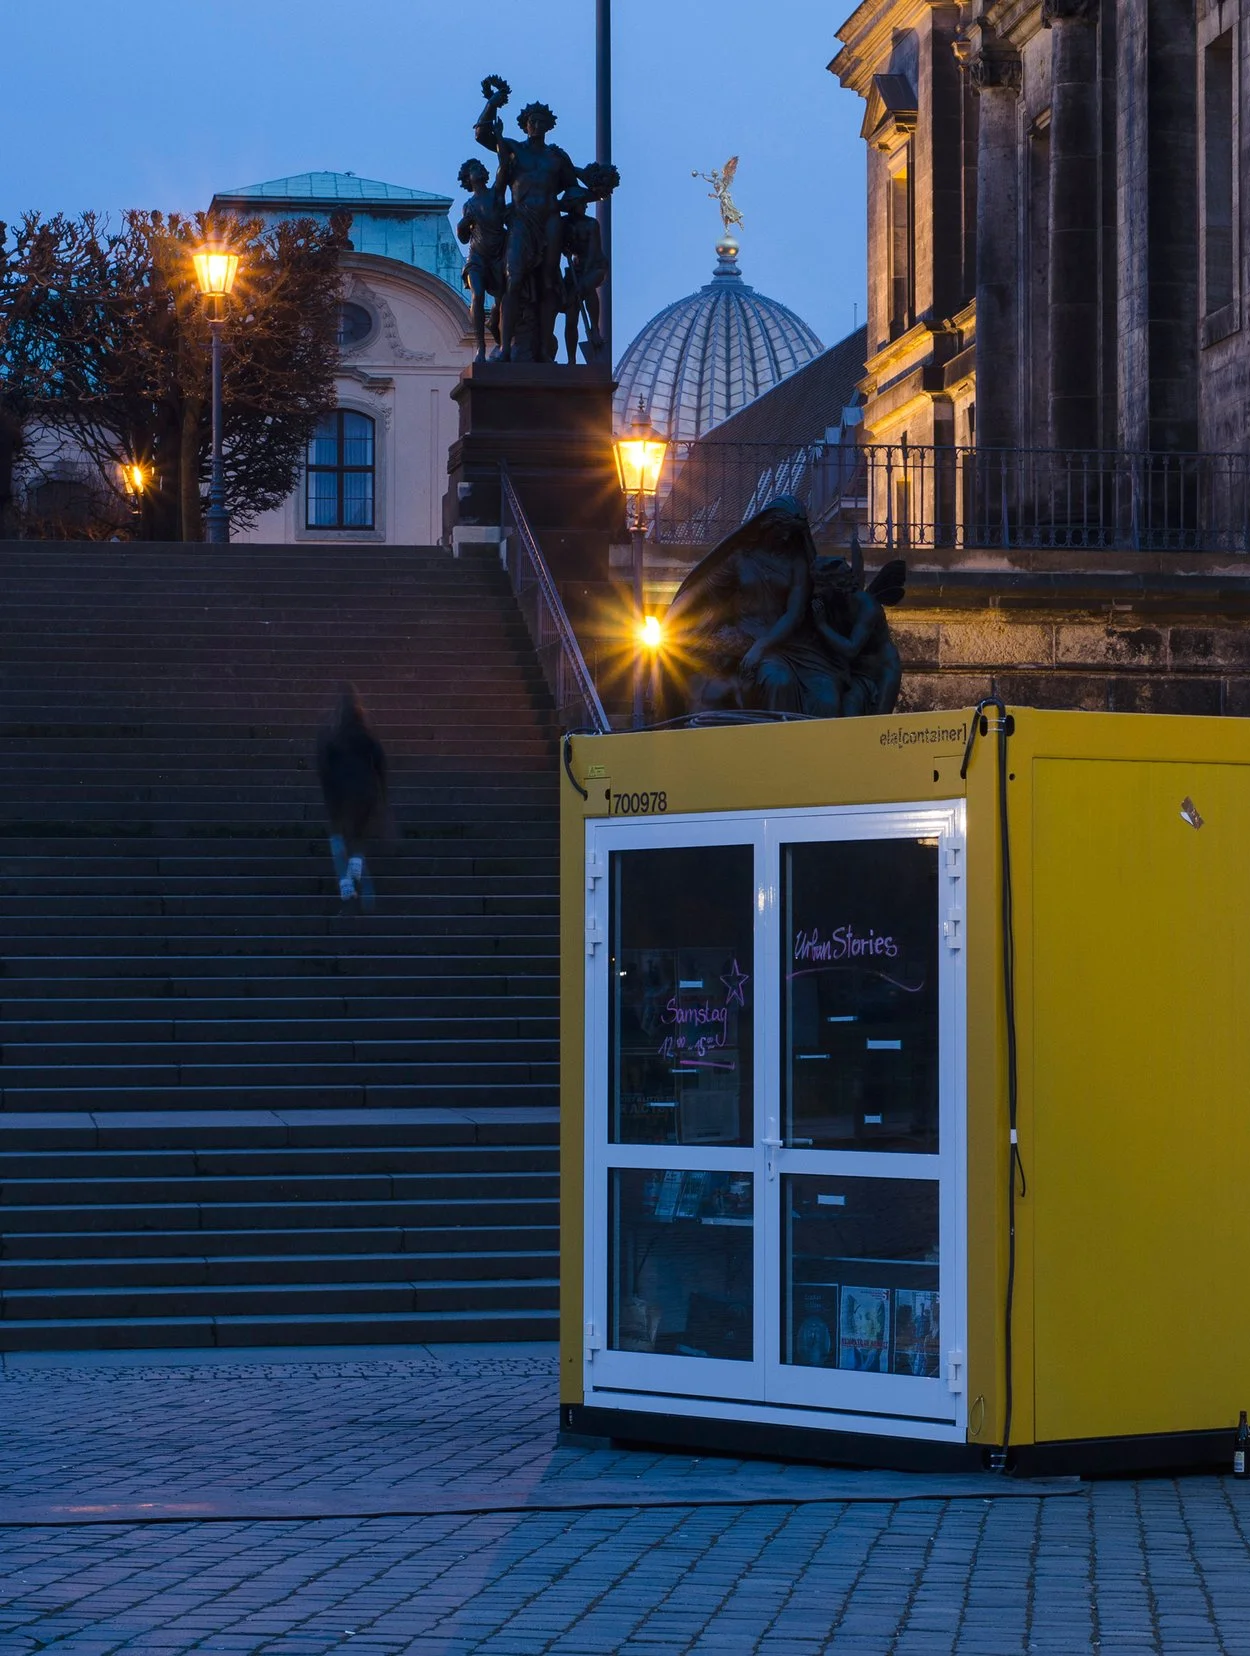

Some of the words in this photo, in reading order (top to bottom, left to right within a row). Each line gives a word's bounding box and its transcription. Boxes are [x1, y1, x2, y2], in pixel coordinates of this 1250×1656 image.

[879, 723, 967, 749] ela[container]
[613, 790, 668, 814] 700978
[794, 927, 831, 961] Urban
[832, 923, 898, 959] Stories
[660, 996, 728, 1048] Samstag
